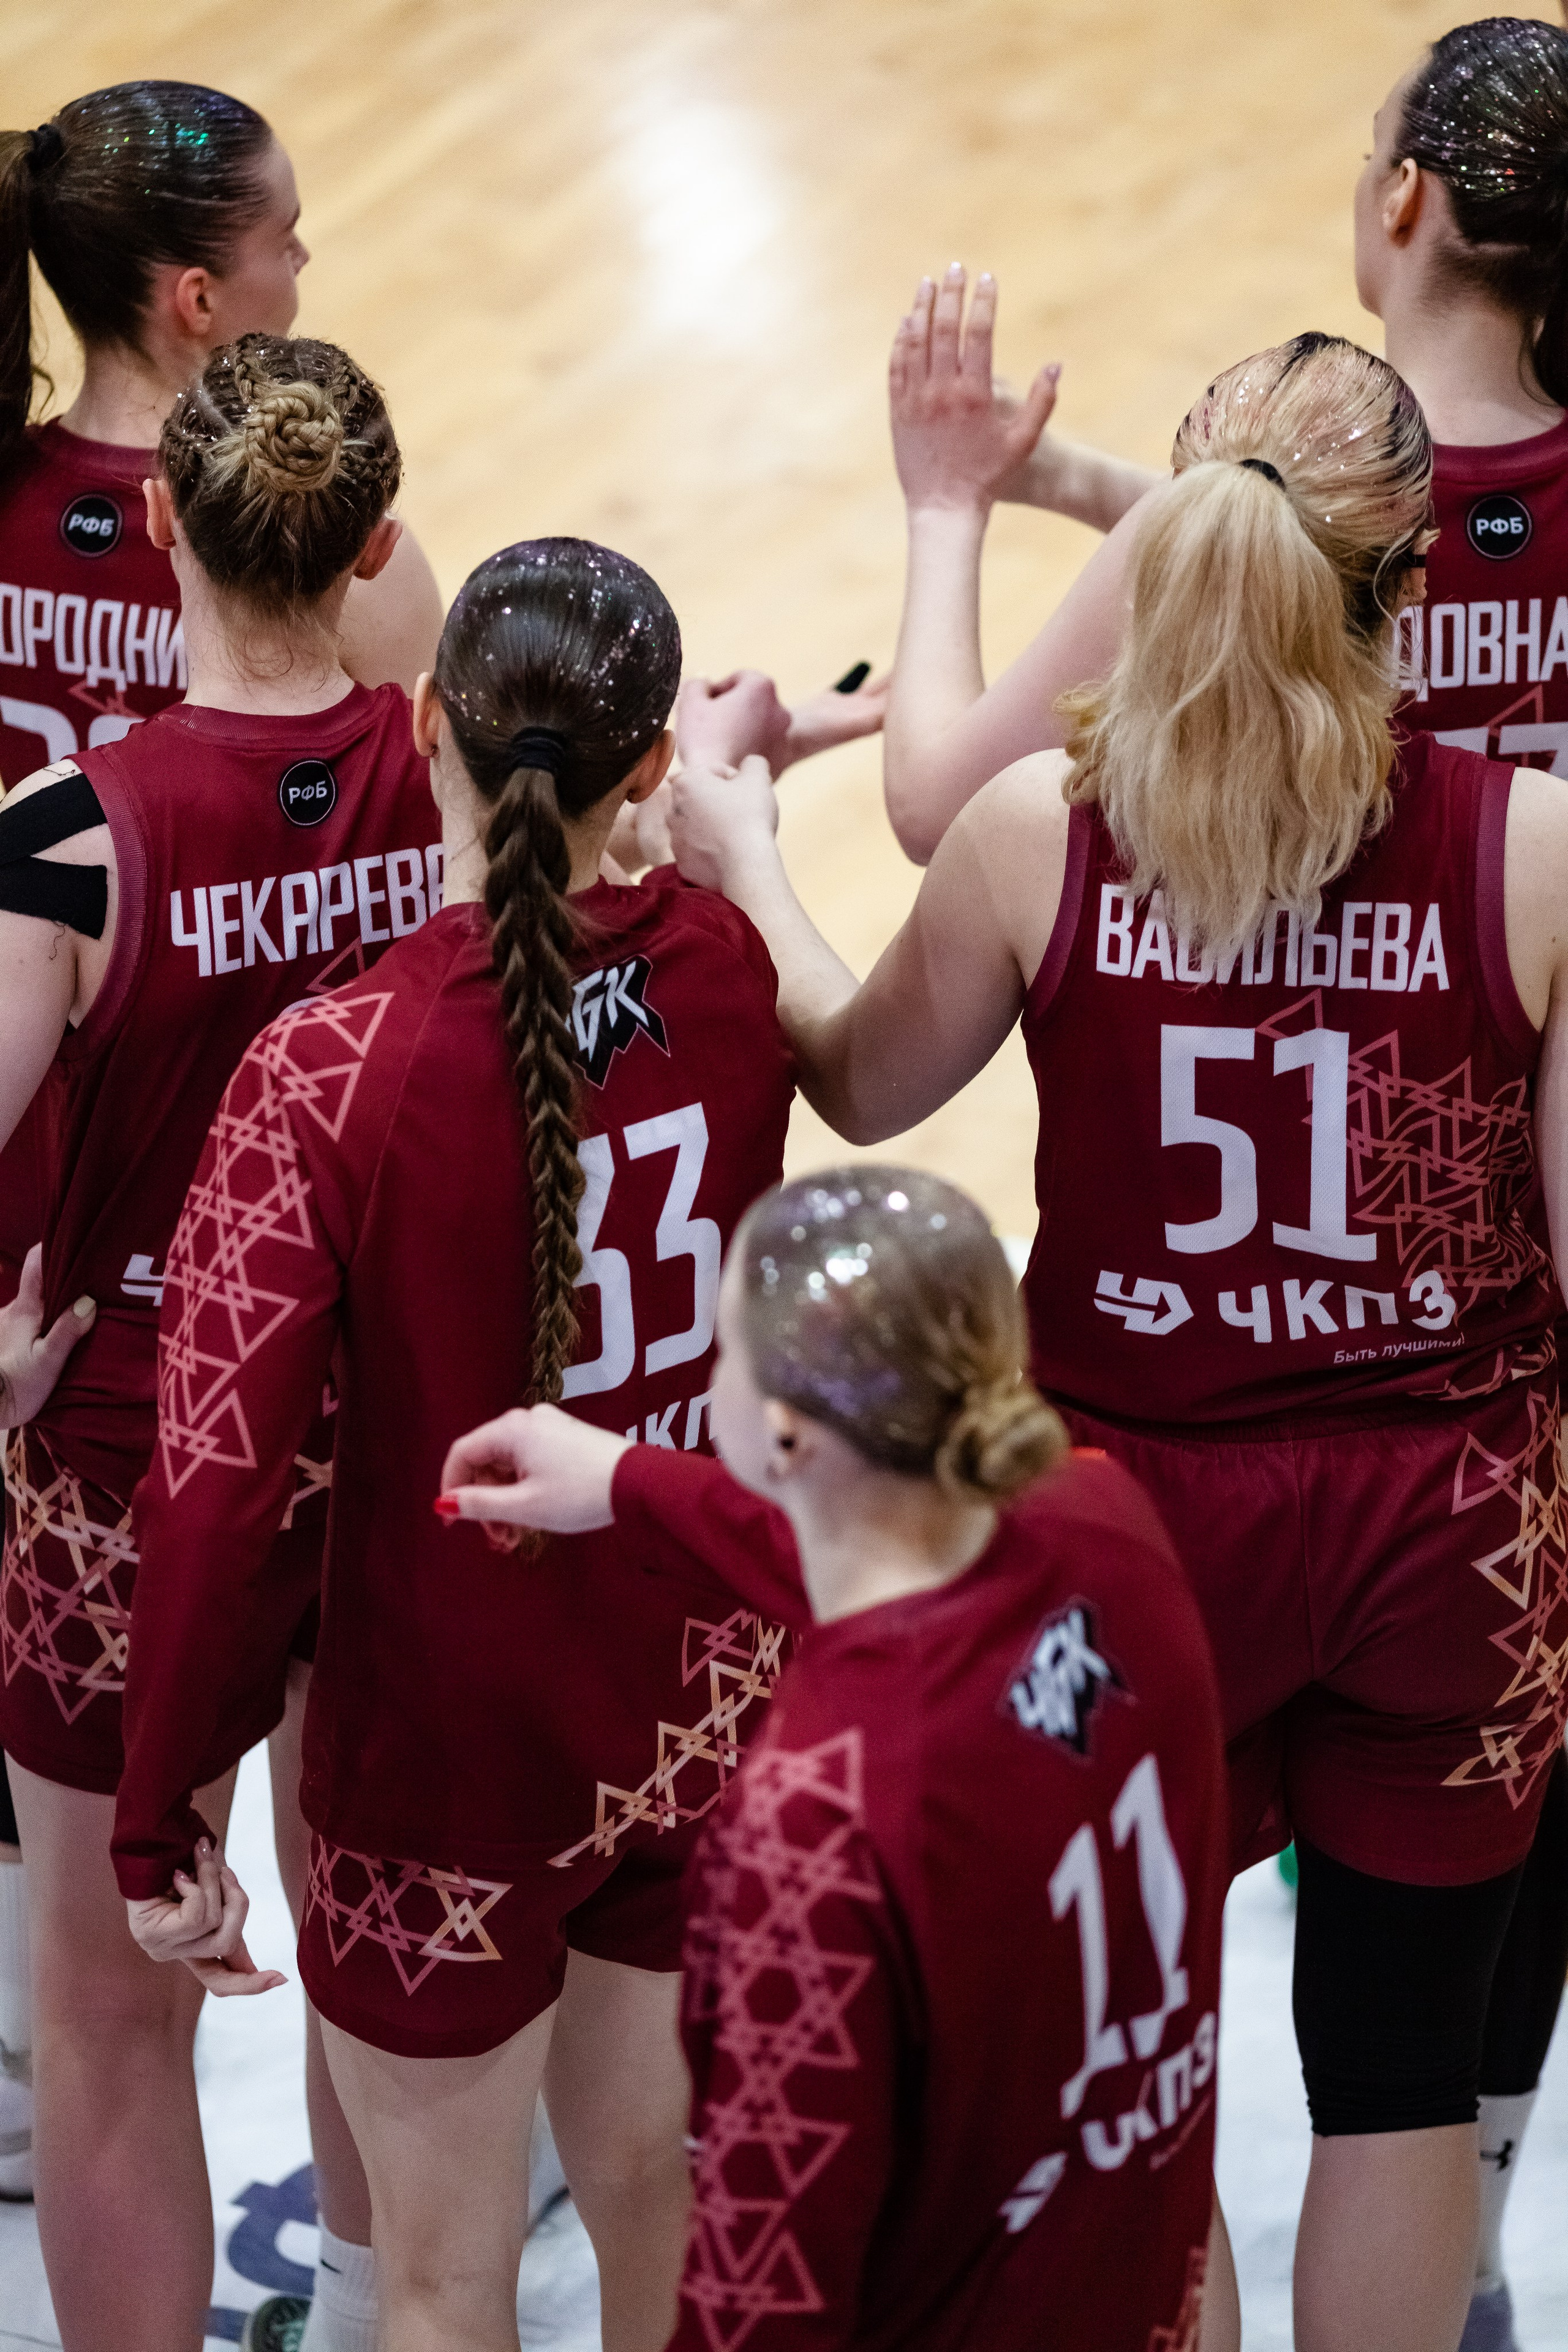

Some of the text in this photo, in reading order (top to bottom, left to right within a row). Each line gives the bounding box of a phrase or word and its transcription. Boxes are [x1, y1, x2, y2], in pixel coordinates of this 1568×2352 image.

[68, 513, 115, 537] РФБ
[1476, 516, 1524, 536] РФБ
[288, 780, 327, 805] РФБ
[564, 960, 649, 1063] БК
[1161, 1024, 1376, 1262] 51
[560, 1102, 722, 1400] 33
[1333, 1349, 1377, 1364] Быть
[626, 1389, 714, 1452] КП
